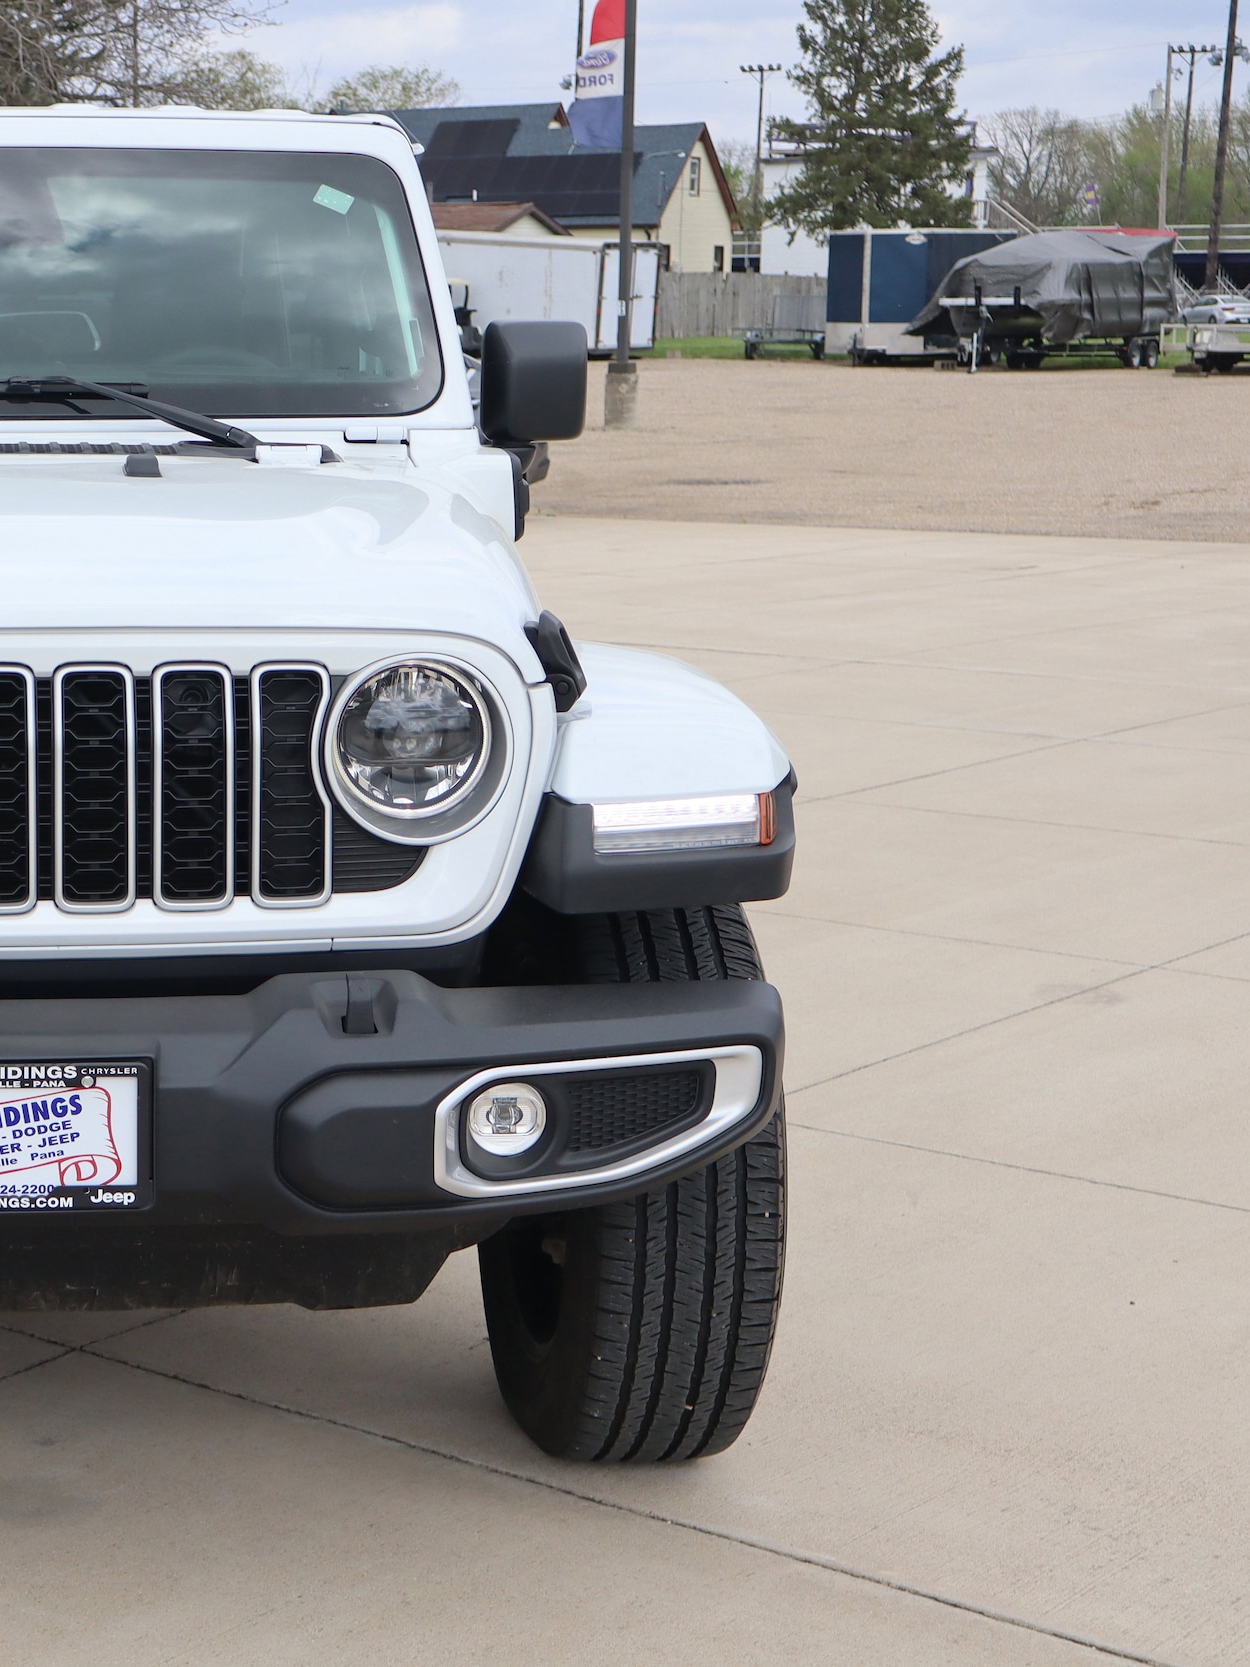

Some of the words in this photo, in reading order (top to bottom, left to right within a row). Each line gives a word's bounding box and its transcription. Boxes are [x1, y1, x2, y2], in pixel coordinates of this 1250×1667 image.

[80, 1067, 138, 1075] CHRYSLER
[33, 1080, 67, 1088] PANA
[12, 1120, 73, 1140] DODGE
[37, 1132, 81, 1148] JEEP
[30, 1150, 65, 1161] Pana
[90, 1189, 136, 1206] Jeep
